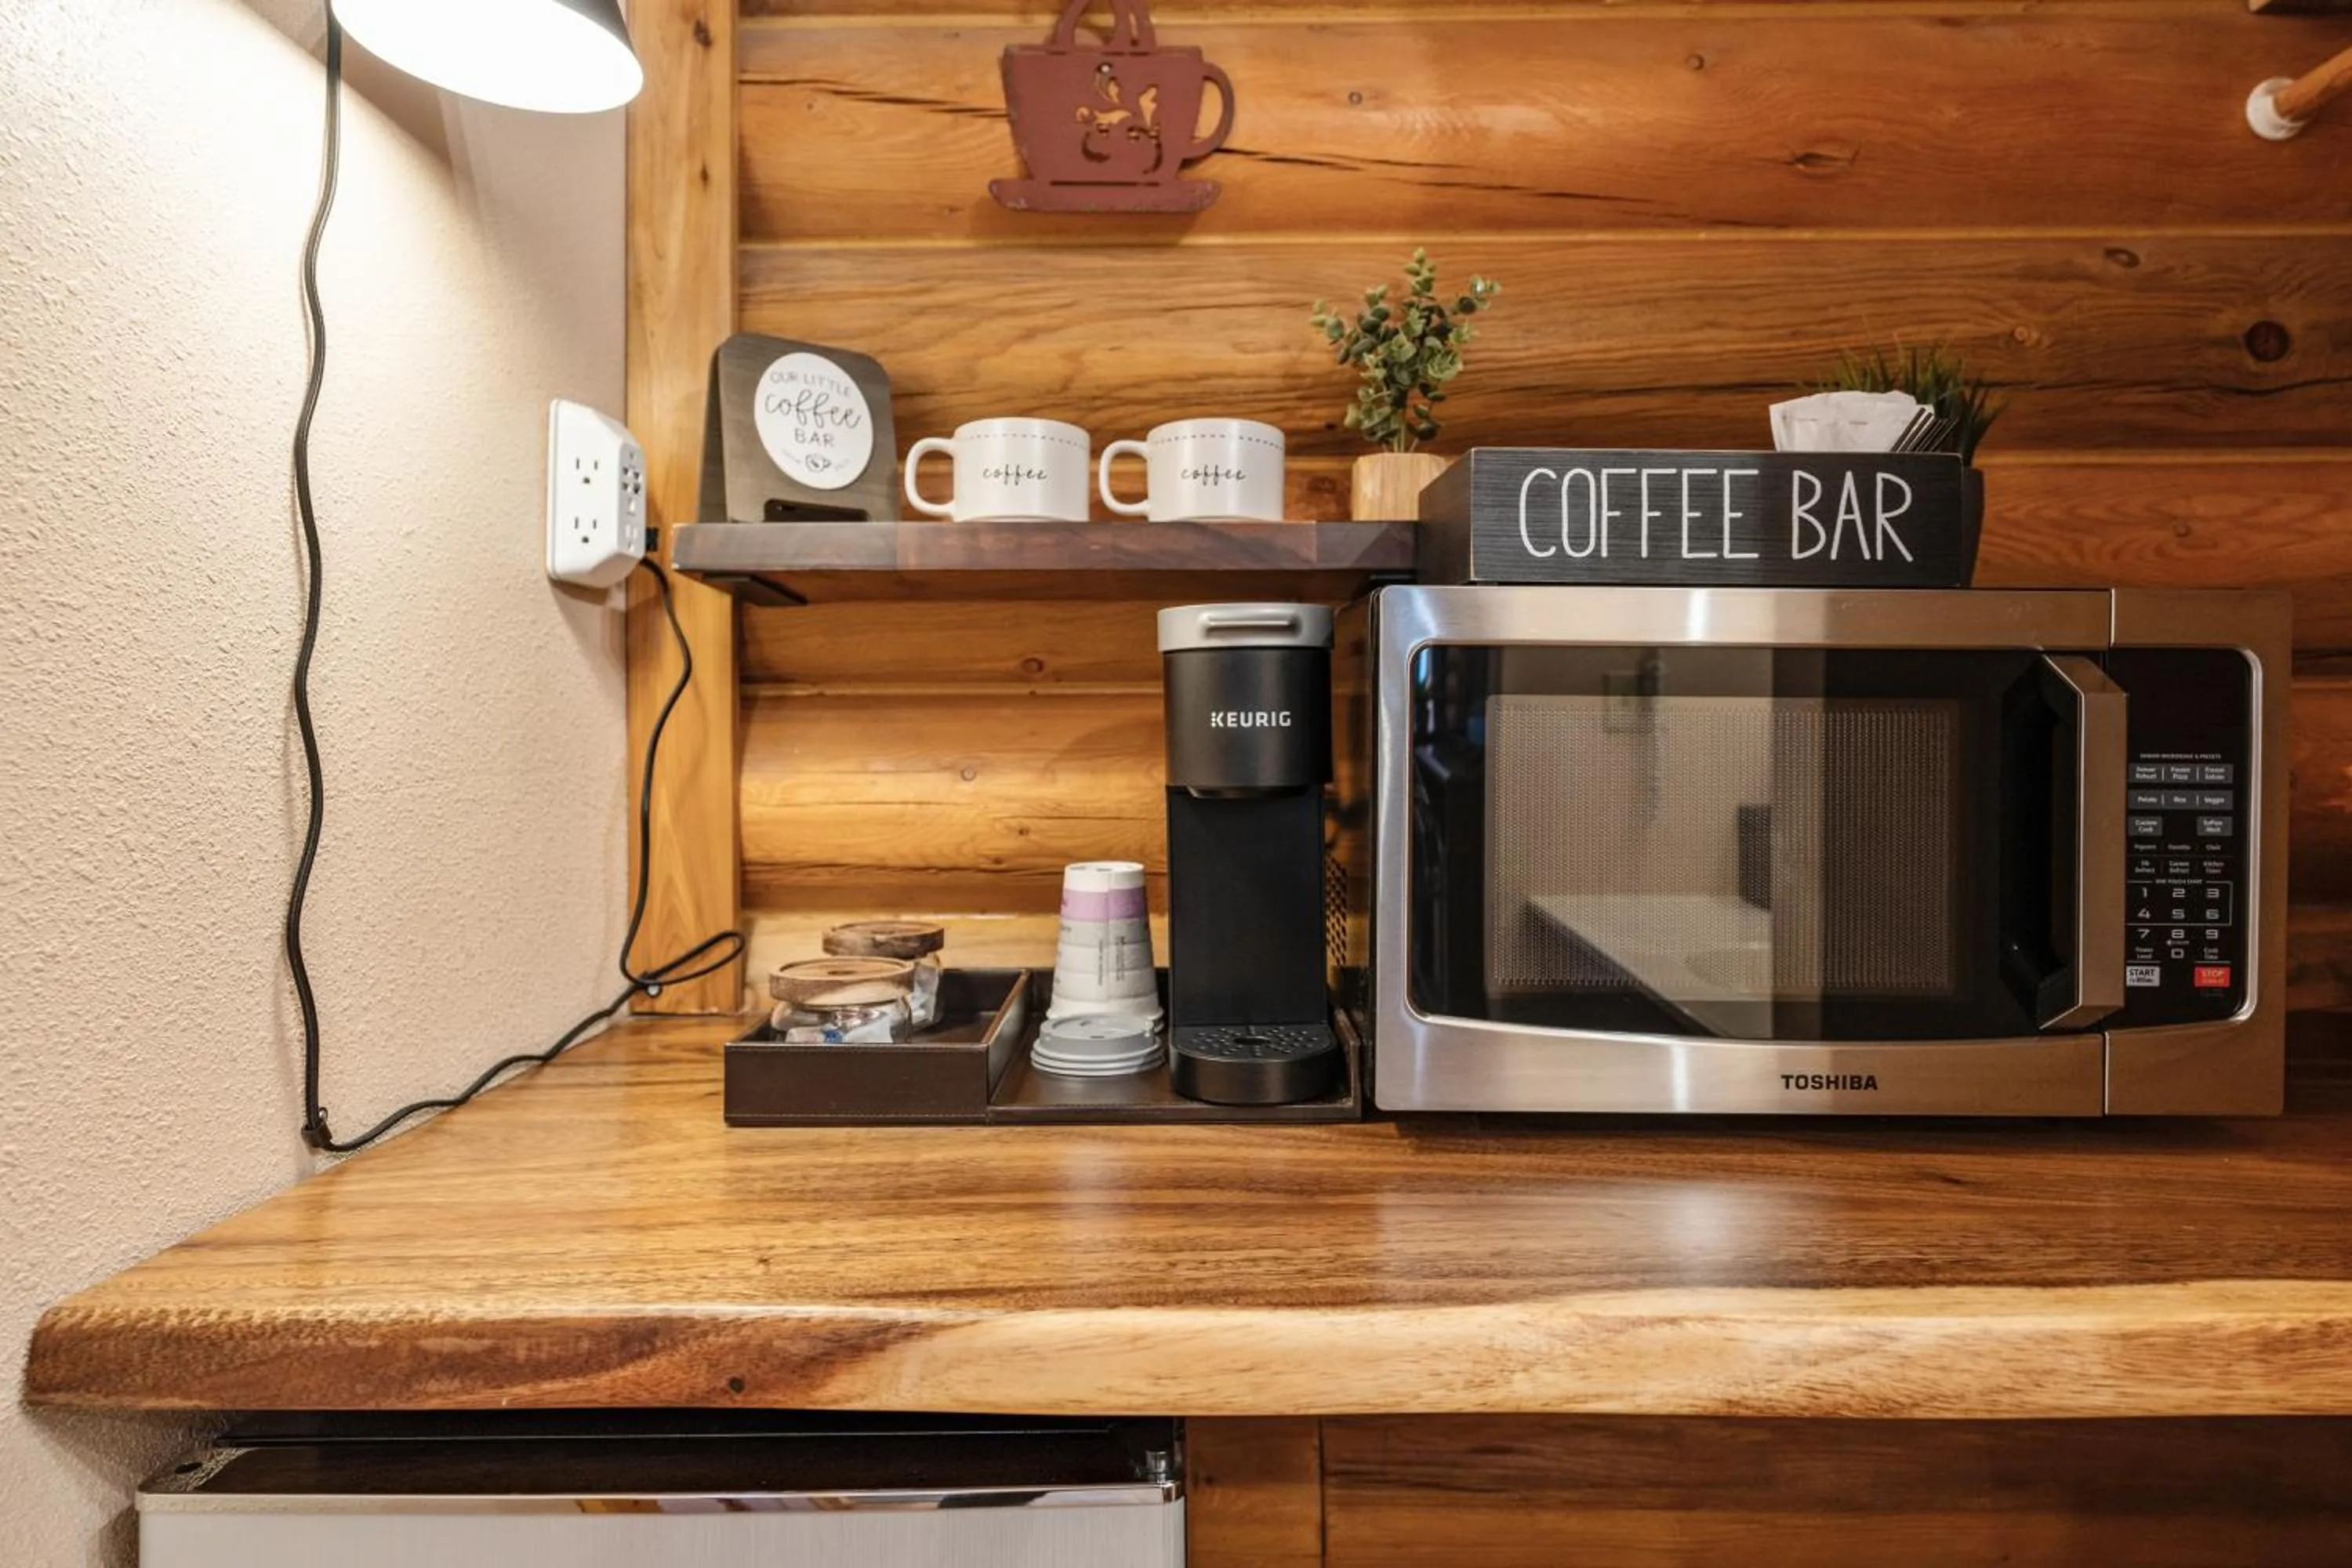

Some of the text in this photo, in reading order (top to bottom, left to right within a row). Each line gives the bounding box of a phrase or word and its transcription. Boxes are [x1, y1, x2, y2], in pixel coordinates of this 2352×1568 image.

[770, 372, 851, 397] OUR LITTLE
[794, 428, 834, 448] BAR
[982, 464, 1047, 486] coffee
[1181, 464, 1247, 486] coffee
[1519, 467, 1914, 562] COFFEE BAR
[1210, 711, 1291, 728] KEURIG
[2142, 887, 2148, 898] 1
[2172, 888, 2185, 898] 2
[2207, 888, 2220, 898] 3
[2137, 909, 2151, 919] 4
[2172, 909, 2185, 920] 5
[2205, 909, 2220, 920] 6
[2137, 928, 2151, 938] 7
[2171, 929, 2184, 938] 8
[2205, 929, 2219, 939] 9
[1780, 1074, 1878, 1091] TOSHIBA
